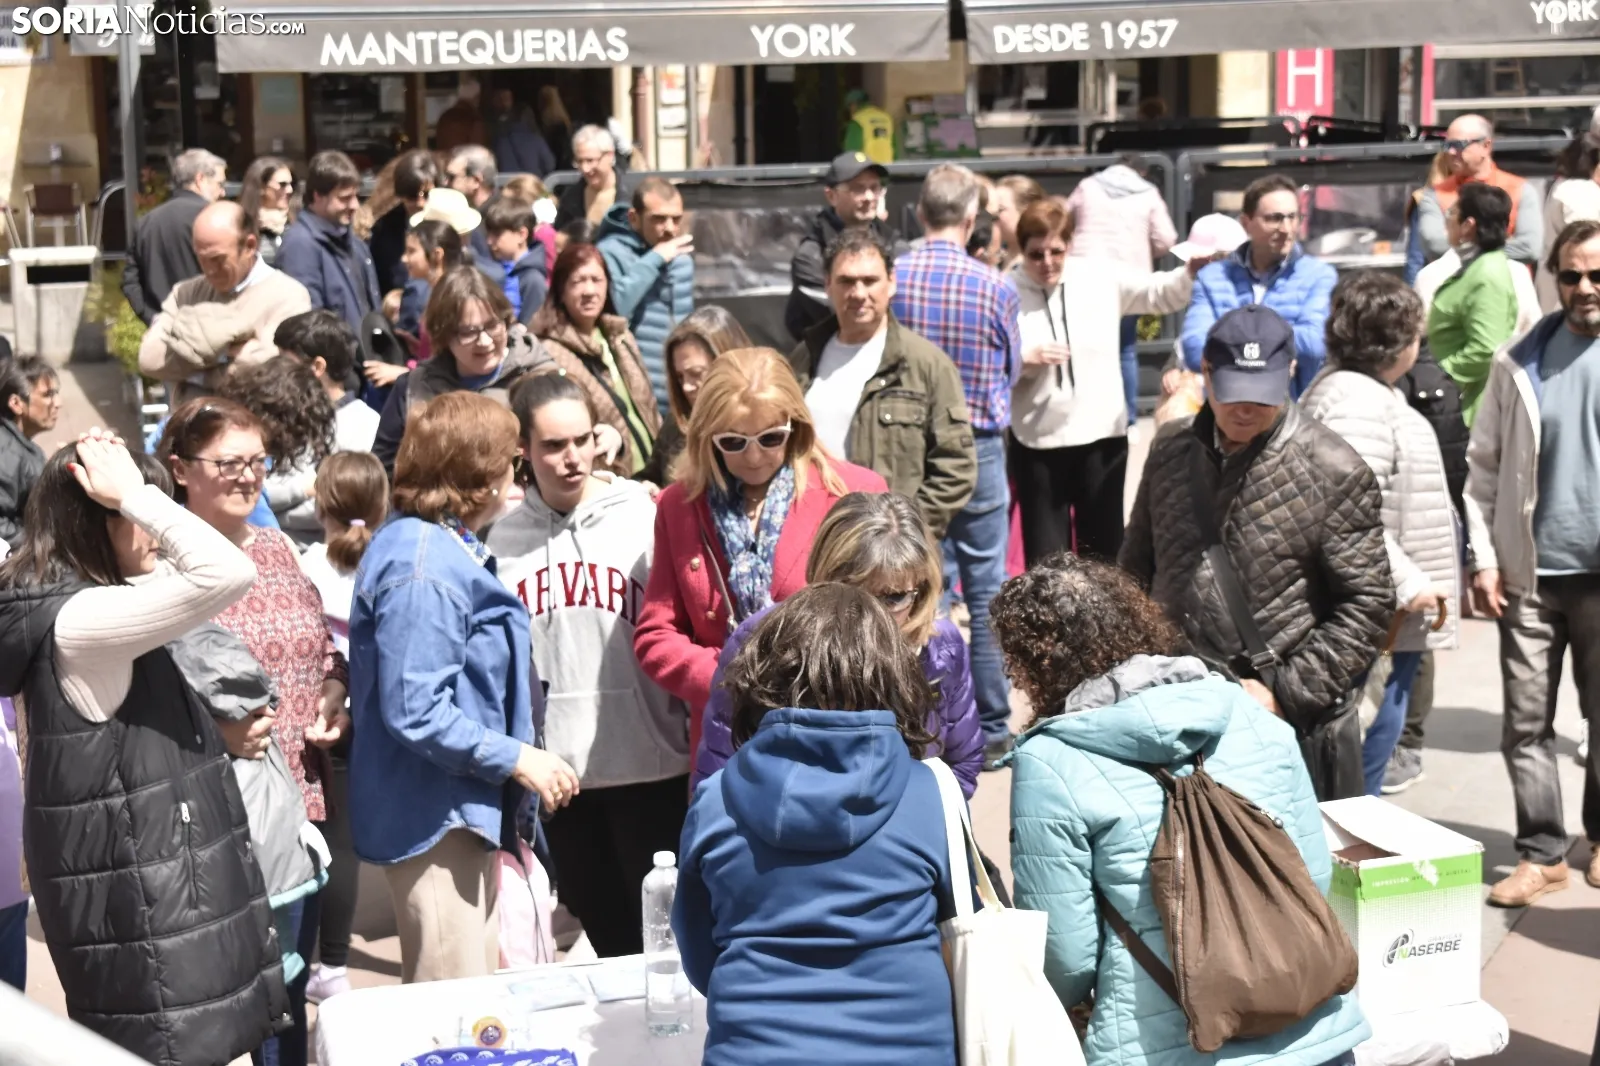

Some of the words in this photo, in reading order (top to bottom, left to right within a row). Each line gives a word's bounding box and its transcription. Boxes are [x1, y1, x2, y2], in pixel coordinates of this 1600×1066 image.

[1529, 0, 1600, 25] YORK
[319, 27, 630, 65] MANTEQUERIAS
[750, 22, 857, 58] YORK
[992, 22, 1090, 54] DESDE
[1100, 18, 1180, 50] 1957
[1397, 939, 1461, 959] NASERBE
